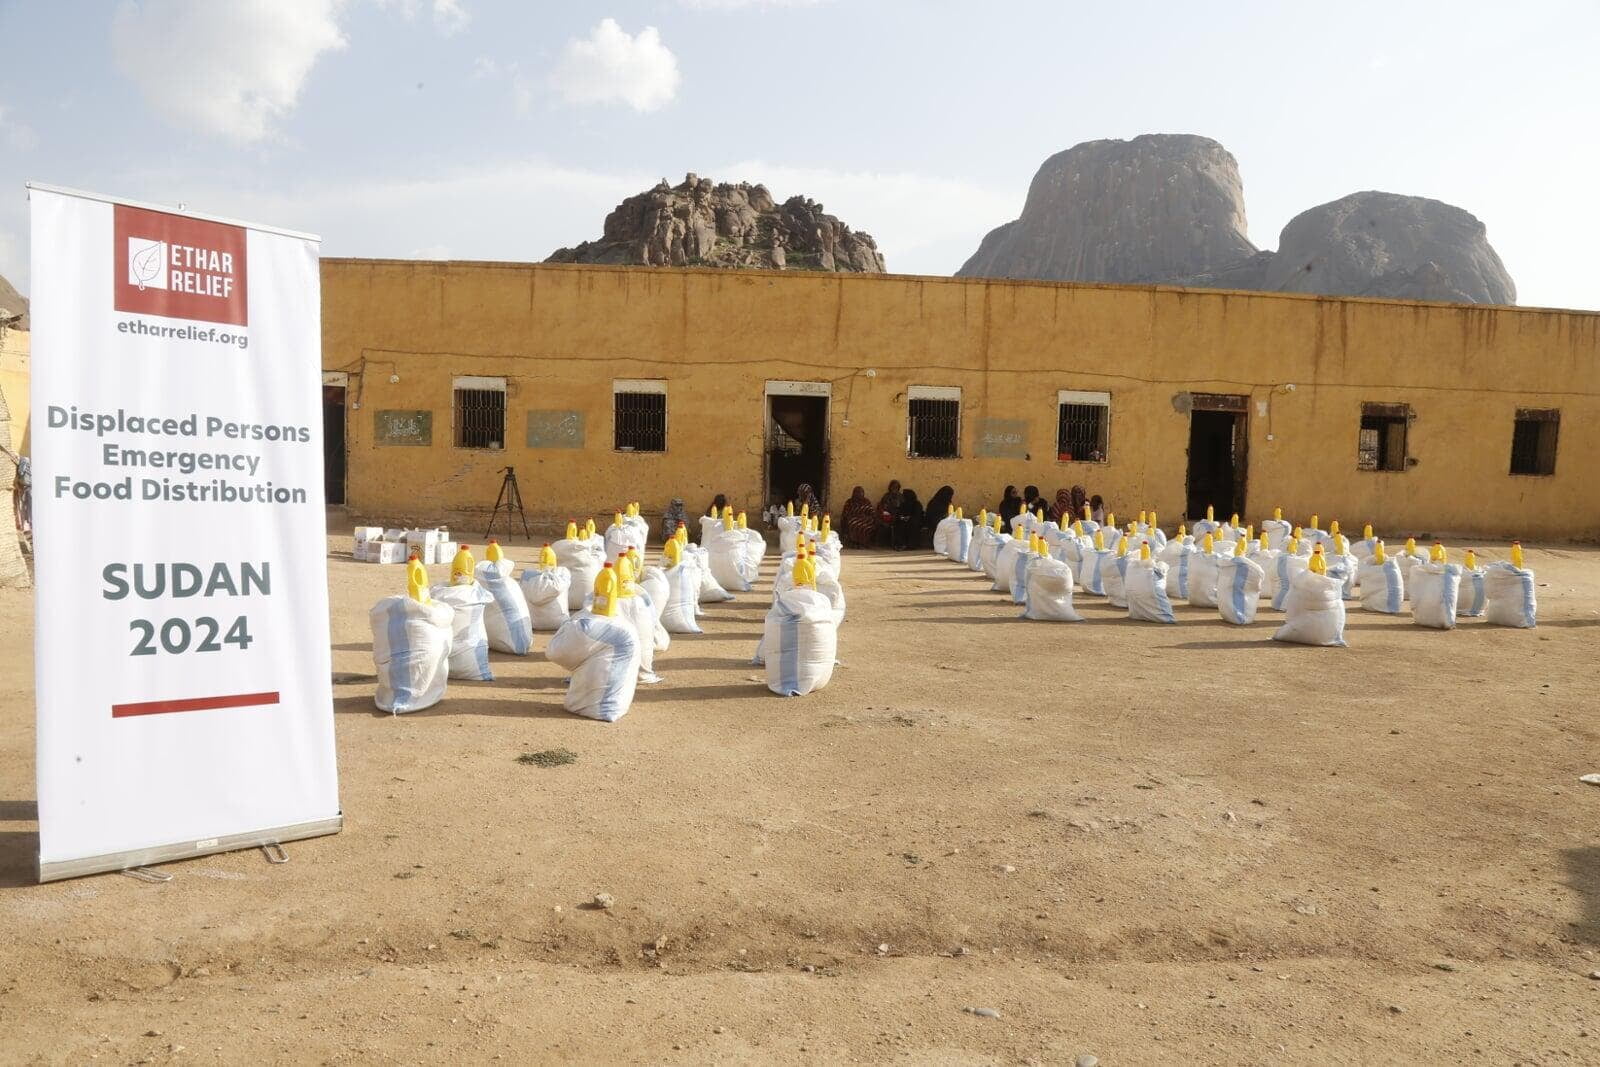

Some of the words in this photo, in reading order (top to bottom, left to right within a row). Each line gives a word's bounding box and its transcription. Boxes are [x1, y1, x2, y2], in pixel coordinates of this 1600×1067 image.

[171, 243, 233, 274] ETHAR
[171, 269, 233, 298] RELIEF
[117, 318, 248, 349] etharrelief.org
[48, 406, 197, 436] Displaced
[207, 416, 309, 442] Persons
[104, 444, 260, 475] Emergency
[56, 477, 131, 500] Food
[143, 478, 306, 503] Distribution
[103, 562, 270, 600] SUDAN
[130, 616, 252, 656] 2024
